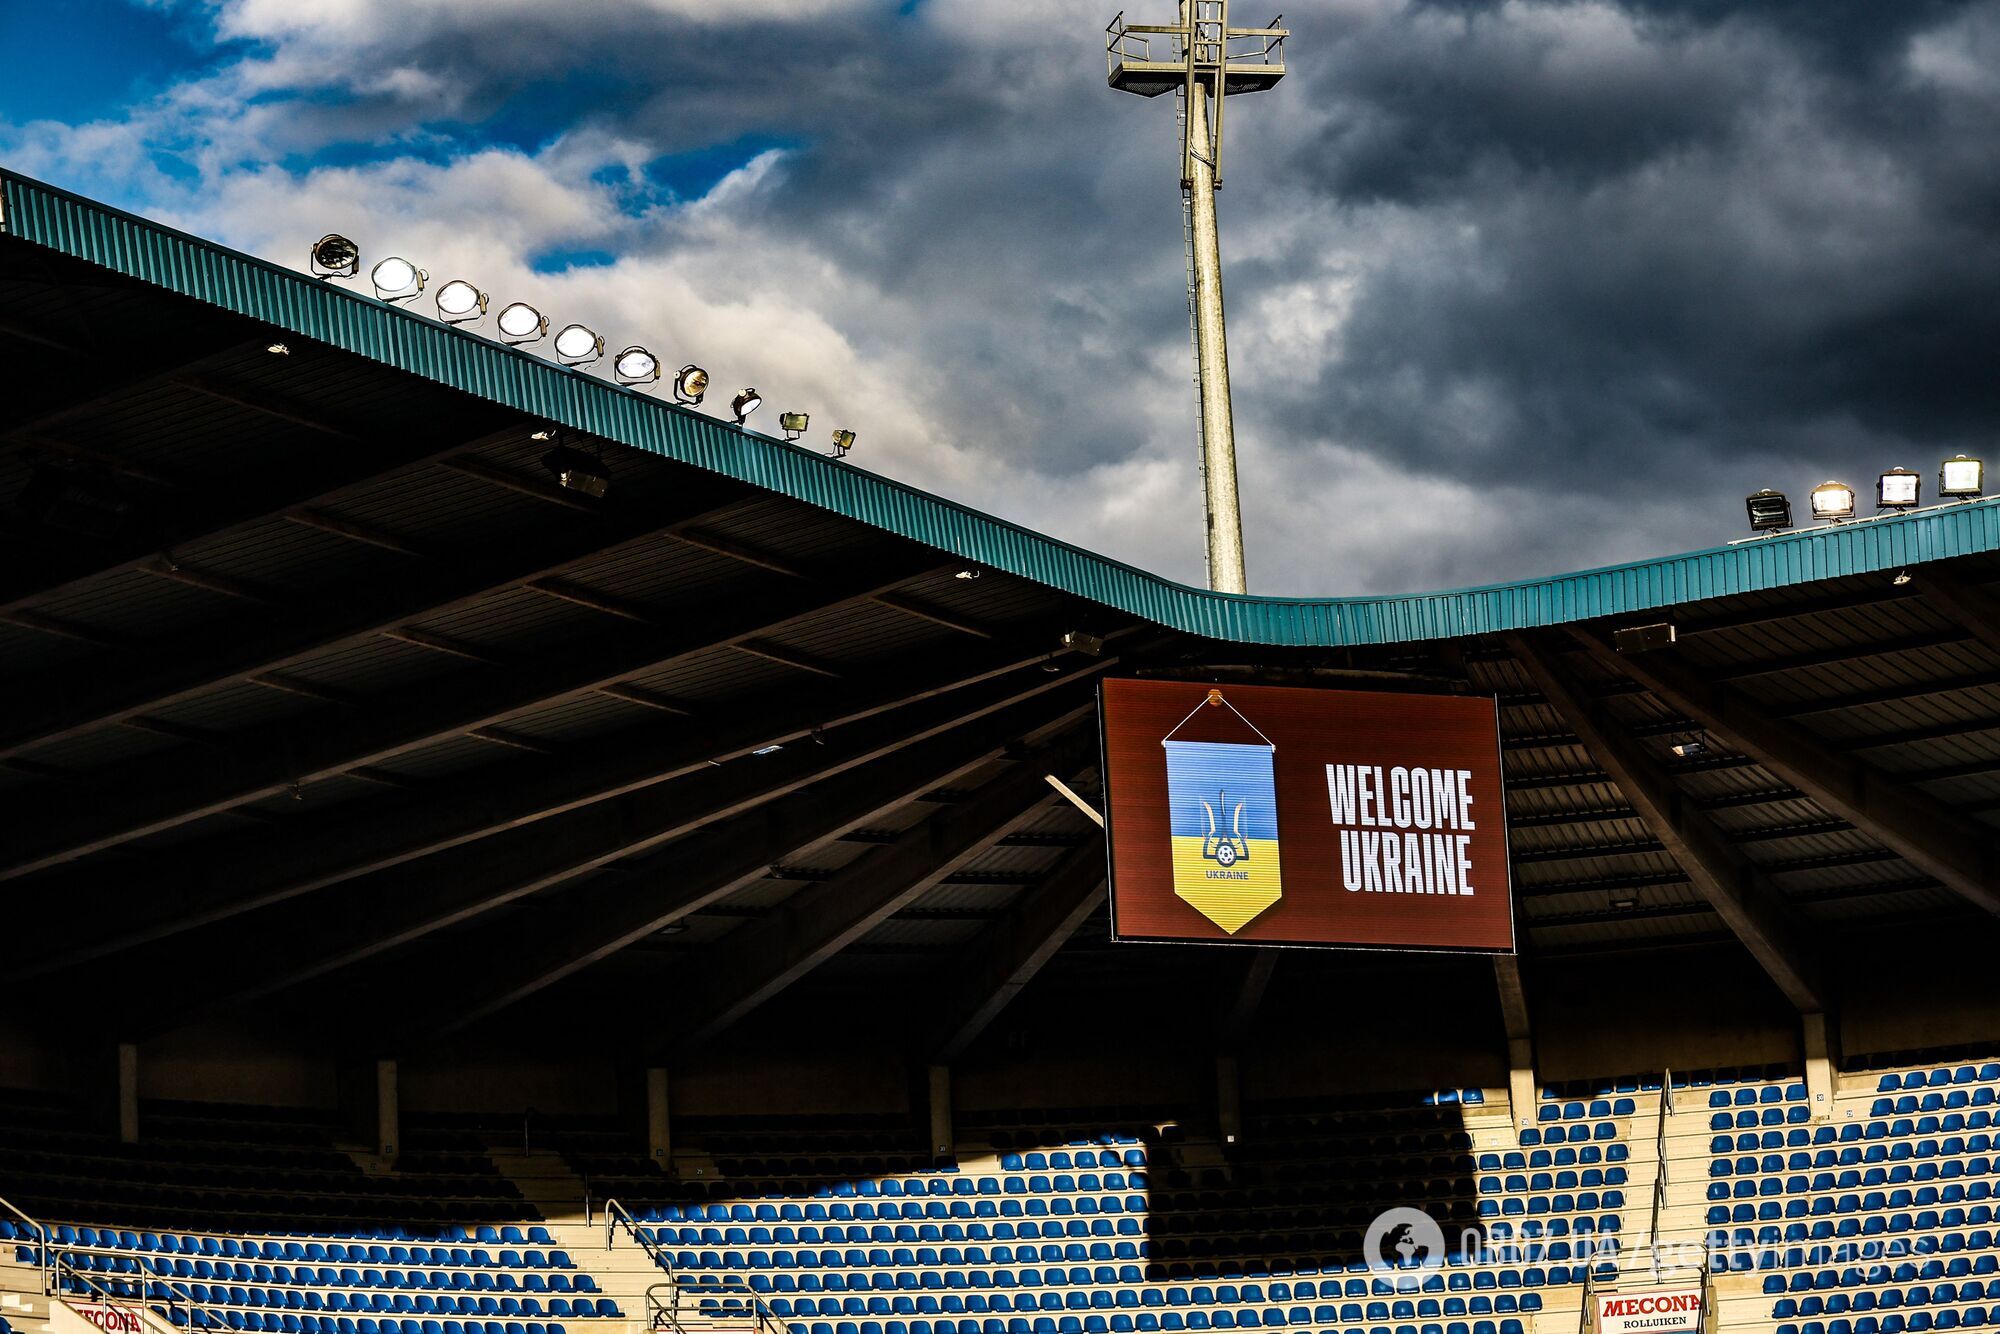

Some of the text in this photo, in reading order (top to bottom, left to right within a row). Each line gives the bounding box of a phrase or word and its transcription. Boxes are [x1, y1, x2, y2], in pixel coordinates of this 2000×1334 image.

[1325, 763, 1475, 831] WELCOME
[1205, 870, 1249, 880] UKRAINE
[1340, 829, 1475, 897] UKRAINE
[1623, 1316, 1687, 1329] ROLLUIKEN
